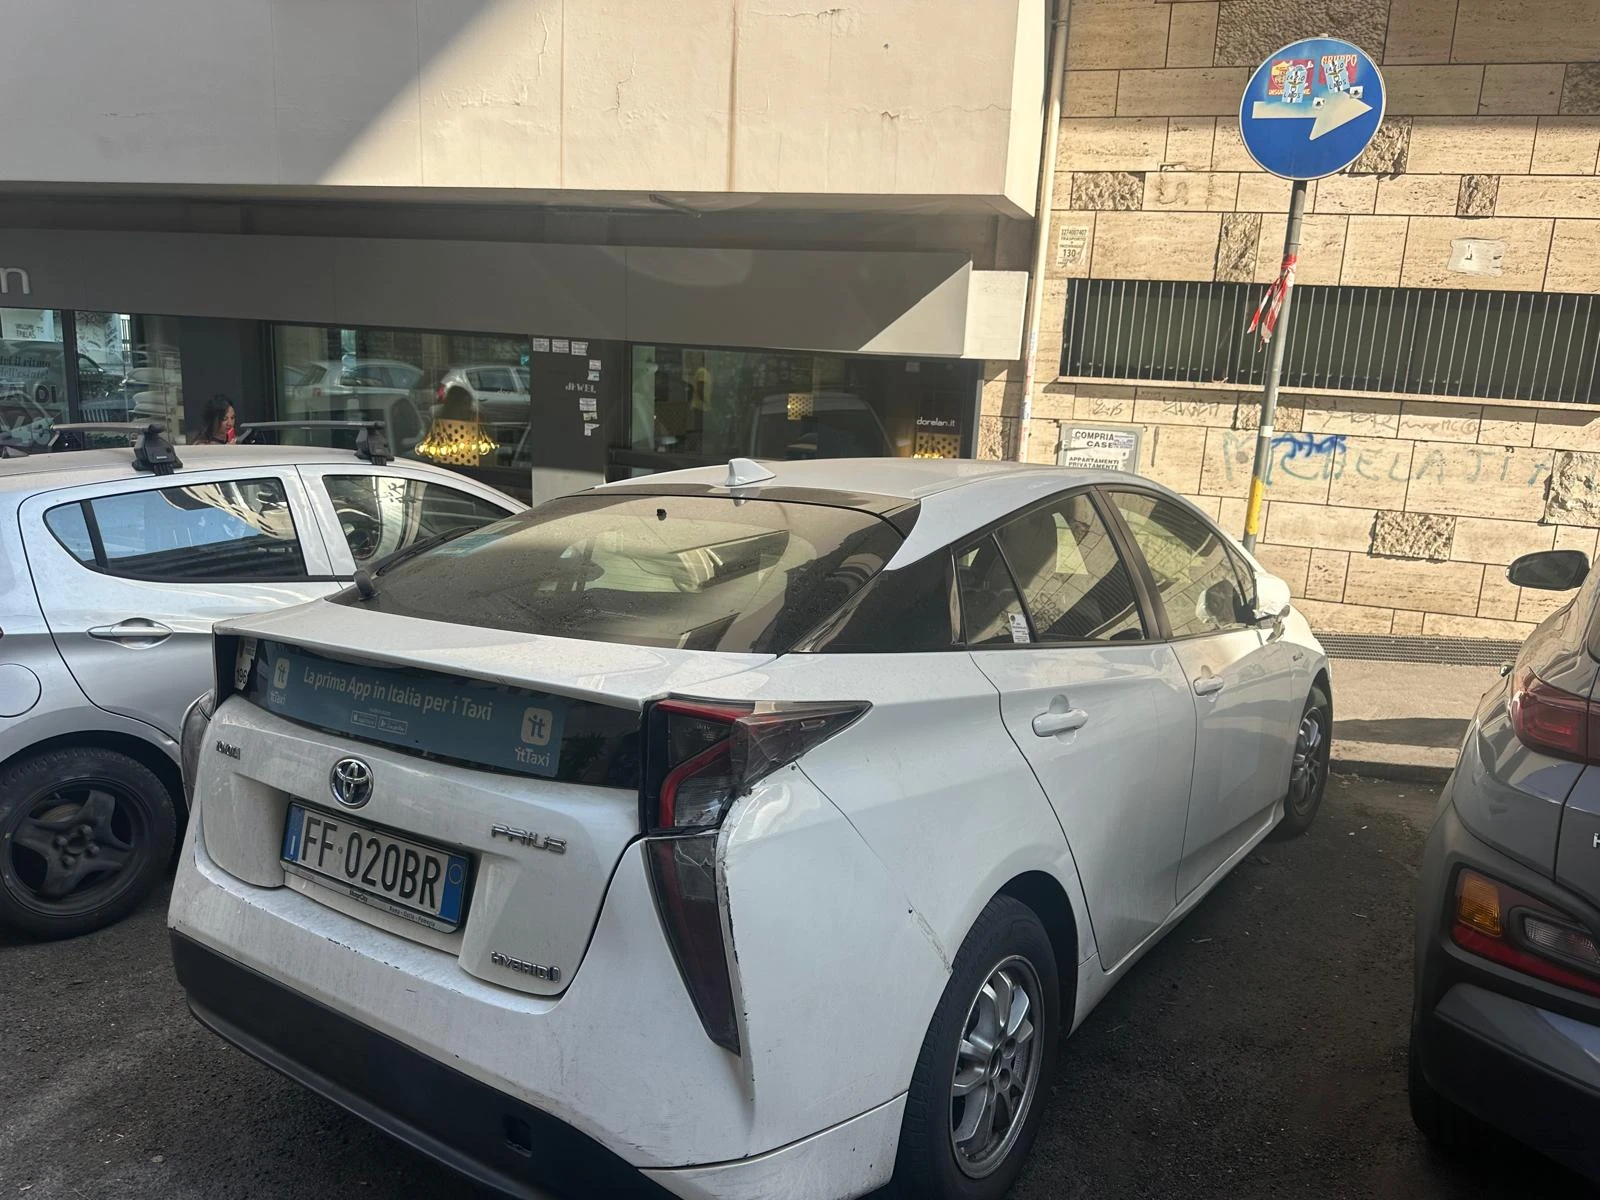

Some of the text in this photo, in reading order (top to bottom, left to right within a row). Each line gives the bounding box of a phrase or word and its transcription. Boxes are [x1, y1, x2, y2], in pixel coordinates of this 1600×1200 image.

[303, 666, 315, 684] La
[314, 671, 346, 692] prima
[347, 676, 372, 701] App
[373, 680, 386, 699] in
[387, 683, 422, 708] Italia
[422, 694, 451, 715] per
[461, 697, 494, 721] Taxi
[491, 823, 567, 856] PRIUS
[490, 950, 549, 980] HYBRID
